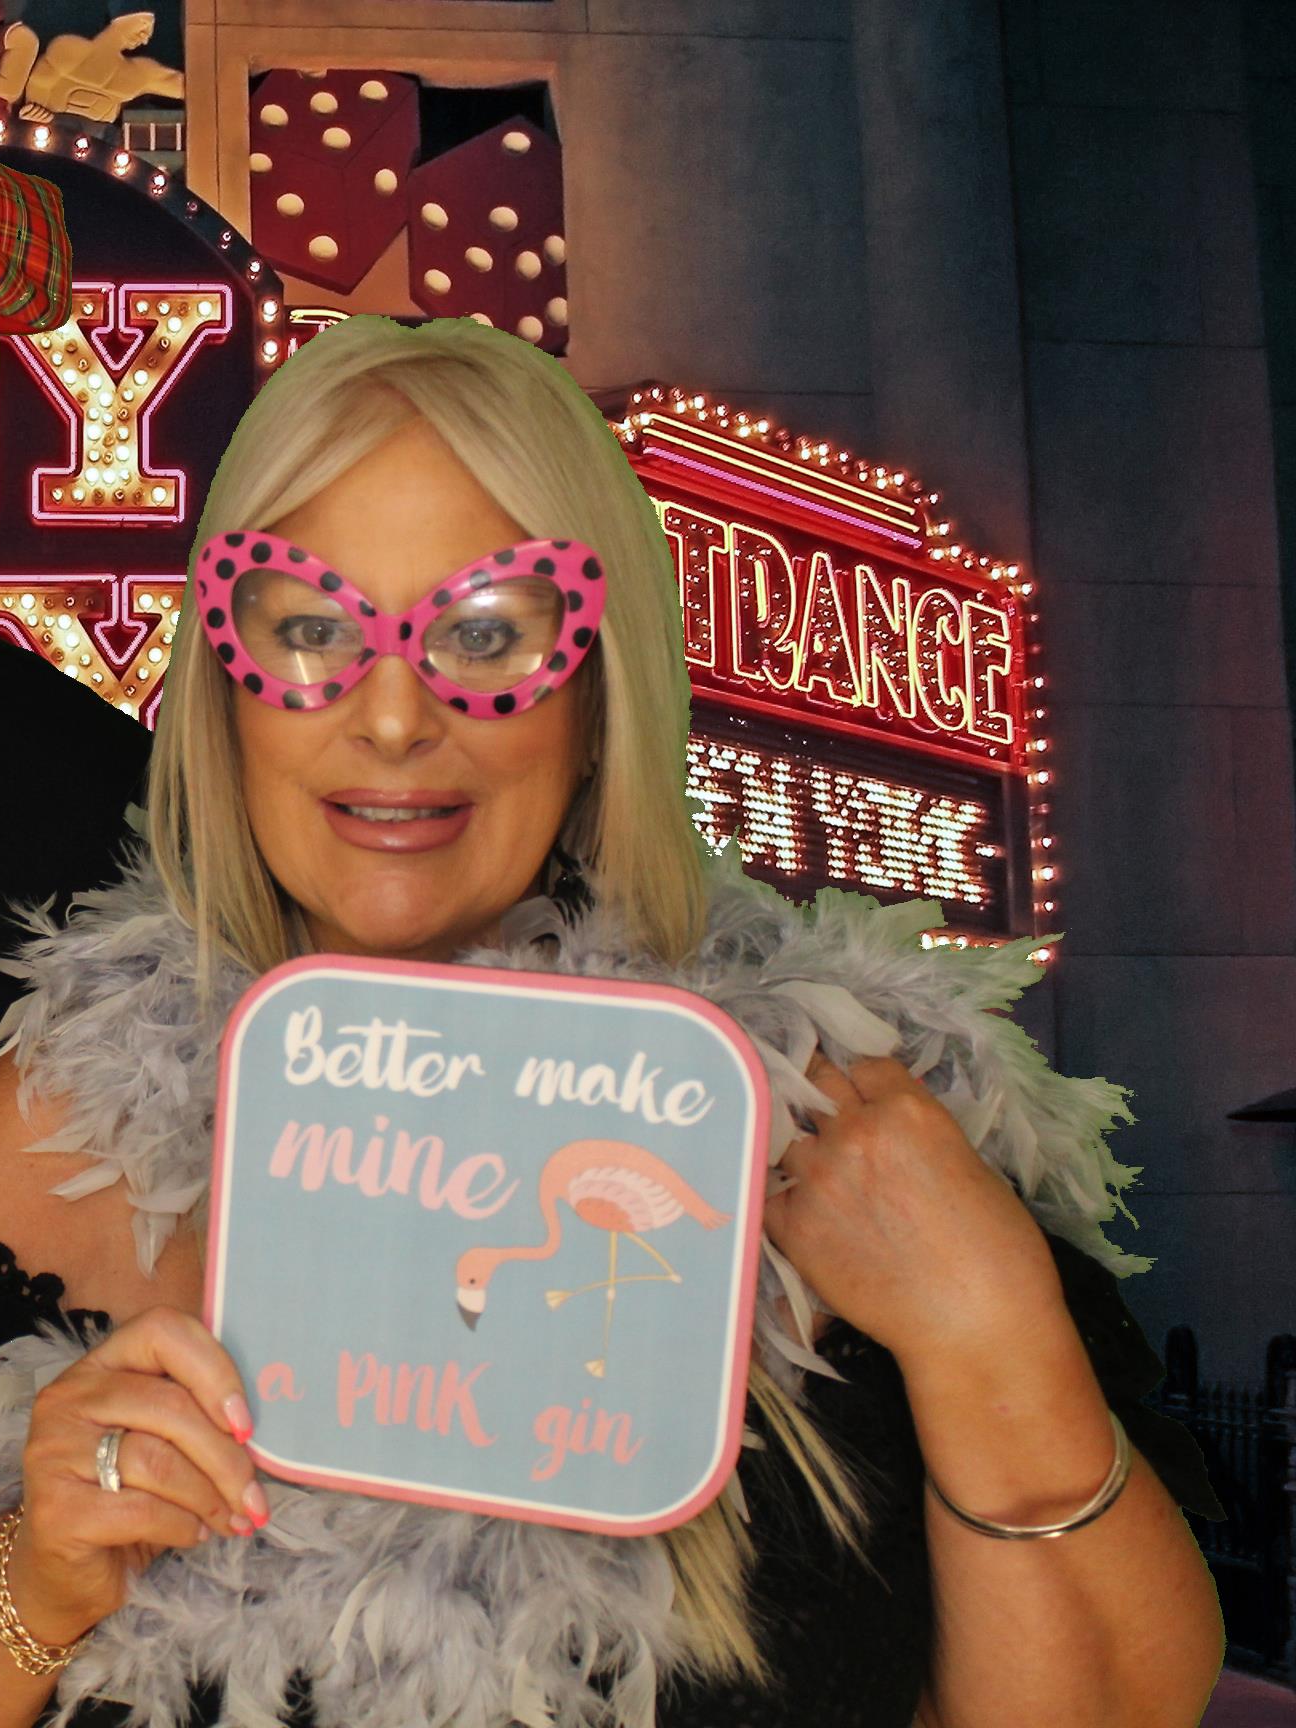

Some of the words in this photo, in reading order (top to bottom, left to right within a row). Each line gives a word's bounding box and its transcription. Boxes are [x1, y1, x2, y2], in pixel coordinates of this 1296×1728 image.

[652, 497, 1015, 745] TRANCE
[284, 1005, 485, 1098] Better
[515, 1051, 714, 1126] make
[268, 1114, 520, 1219] mine
[256, 1361, 304, 1402] a
[530, 1398, 643, 1482] gin
